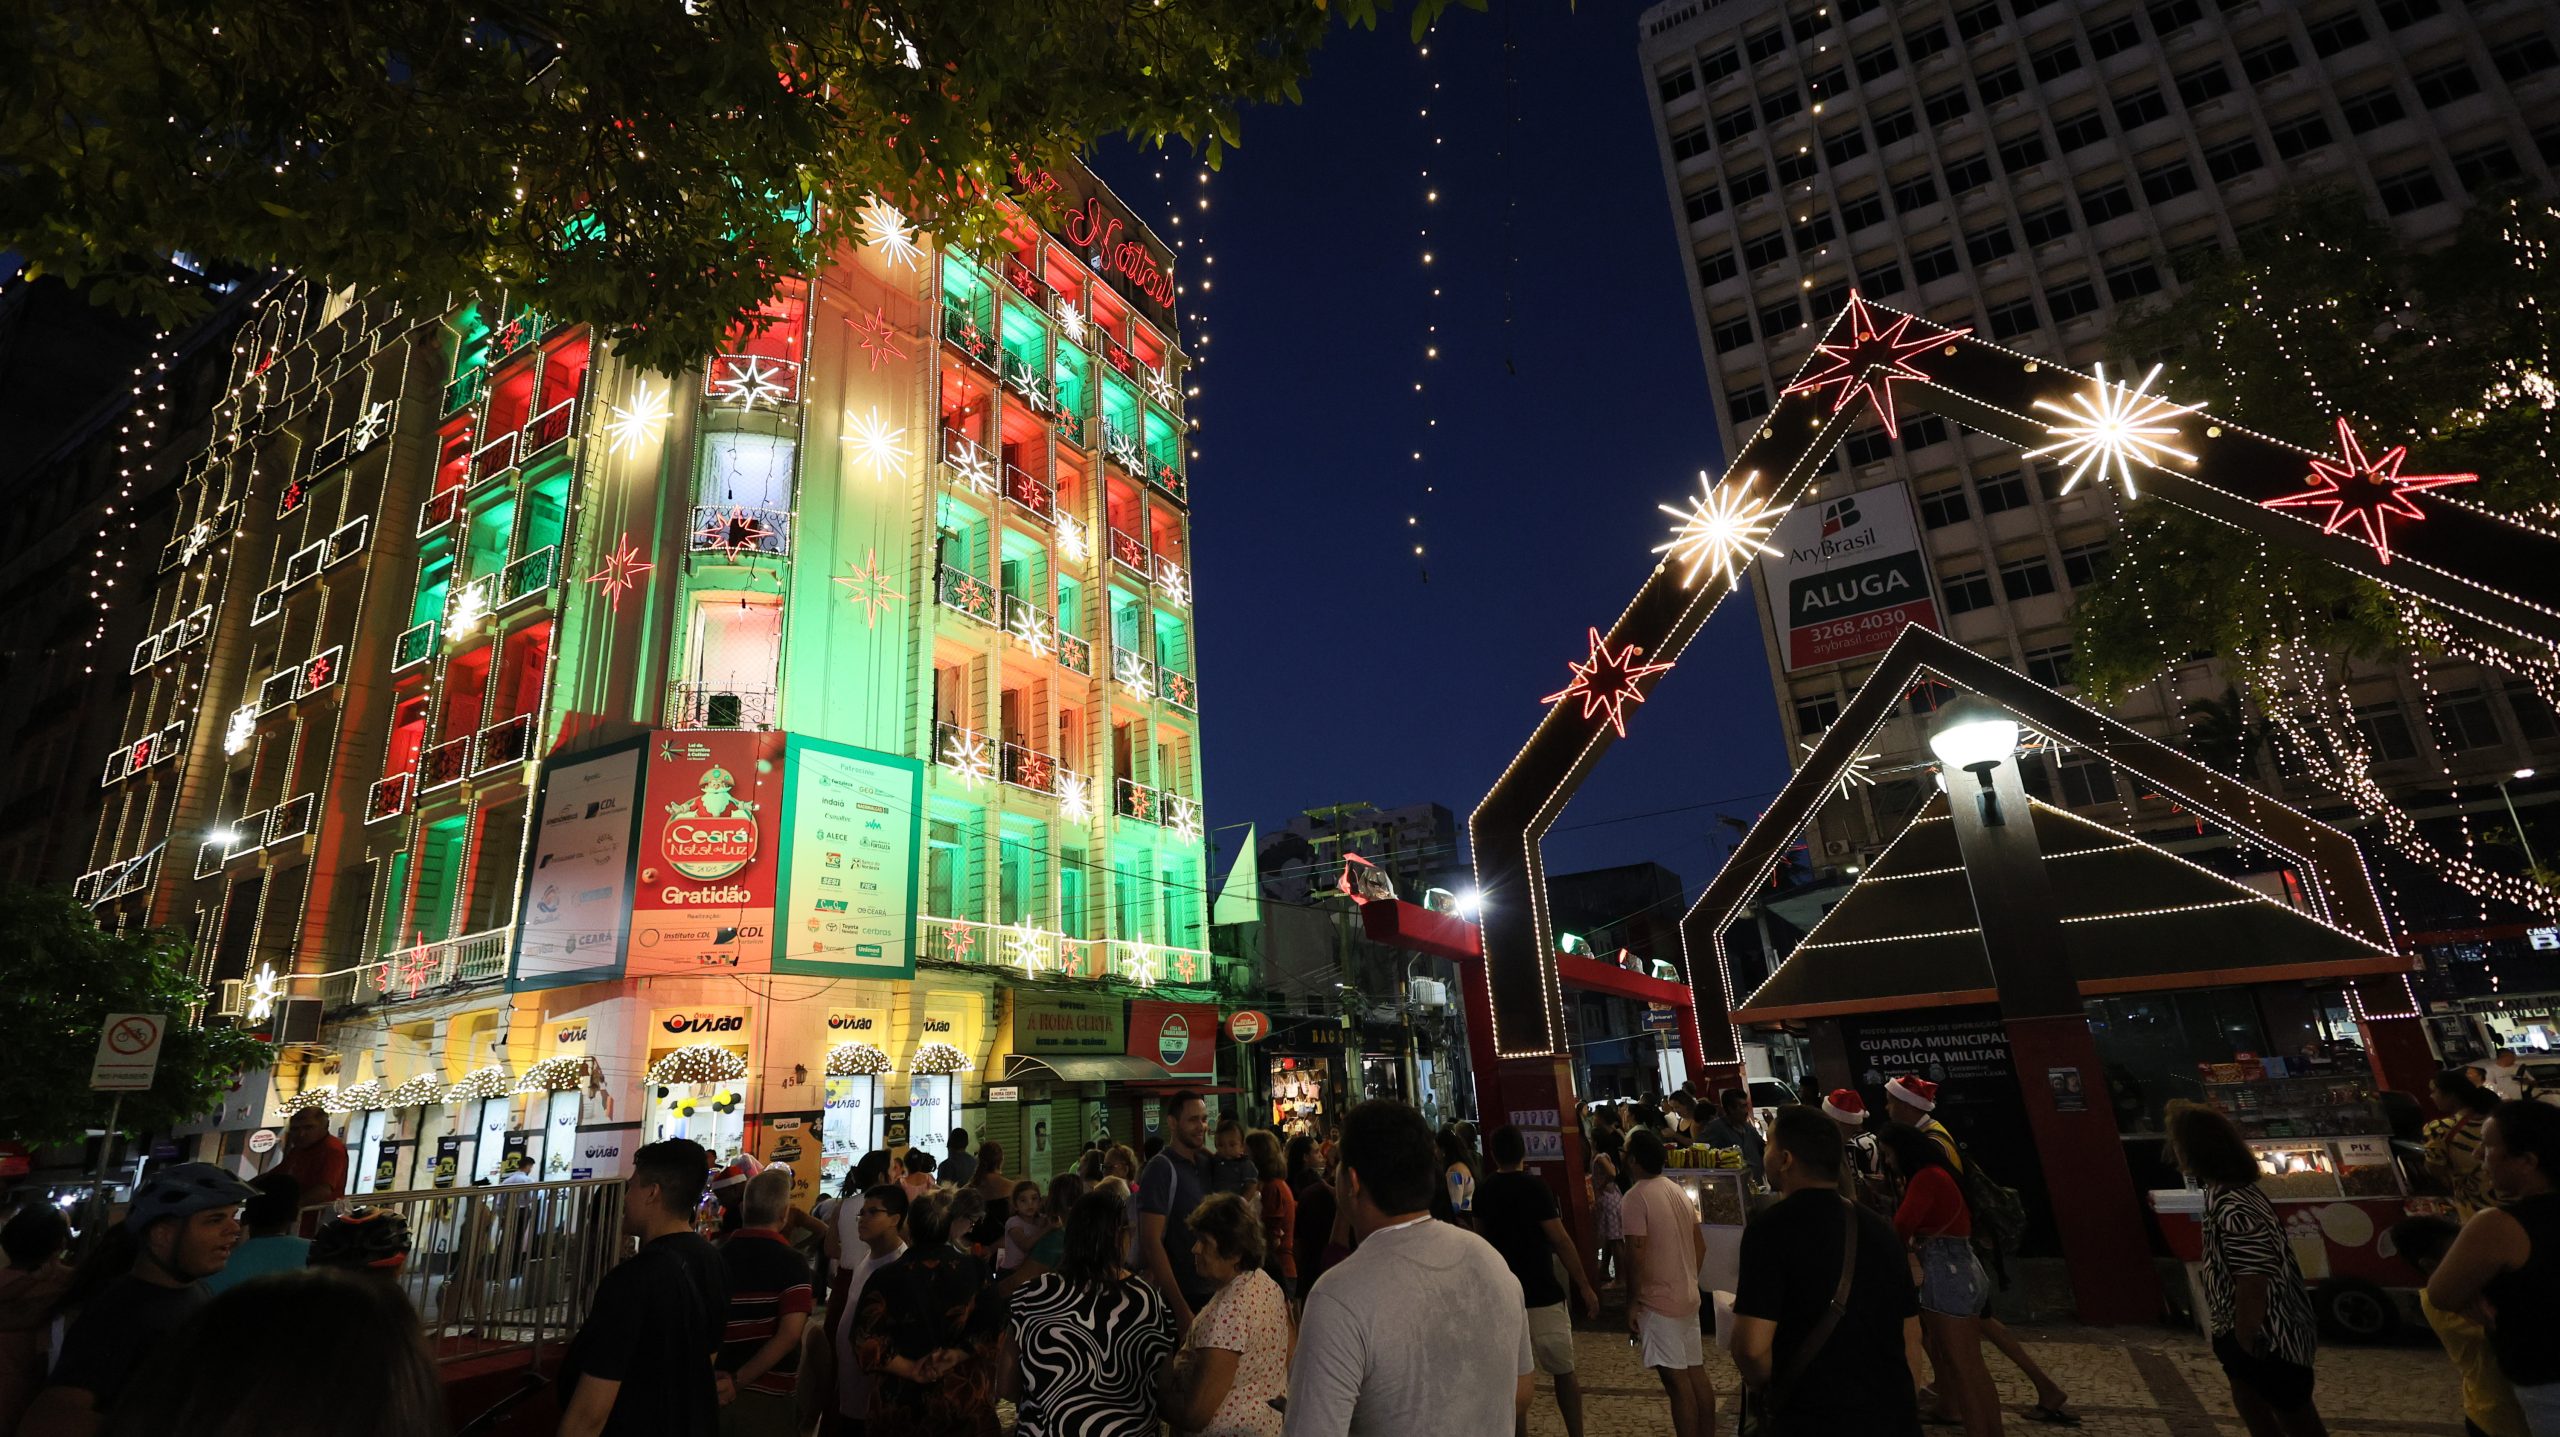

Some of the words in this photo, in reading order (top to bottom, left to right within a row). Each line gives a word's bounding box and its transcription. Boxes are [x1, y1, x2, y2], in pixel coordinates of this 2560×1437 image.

[1789, 528, 1876, 565] AryBrasil
[1801, 569, 1910, 612] ALUGA
[1811, 609, 1906, 642] 3268.4030
[600, 797, 616, 810] CDL
[671, 825, 748, 844] Ceará
[826, 832, 848, 842] ALECE
[670, 843, 712, 856] Natal
[723, 843, 748, 855] Luz
[661, 884, 752, 905] Gratidão
[579, 929, 613, 946] CEARÁ
[664, 932, 695, 940] Instituto
[696, 931, 711, 939] CDL
[739, 926, 764, 938] CDL
[2526, 926, 2559, 936] CASAS
[858, 945, 880, 953] Unimed
[1311, 1028, 1345, 1044] BAGS
[1860, 1038, 1923, 1051] GUARDA
[1926, 1032, 2010, 1048] MUNICIPAL
[1870, 1055, 1880, 1066] E
[1883, 1051, 1941, 1066] POLÍCIA
[1944, 1048, 2007, 1063] MILITAR
[2350, 1143, 2372, 1151] PIX
